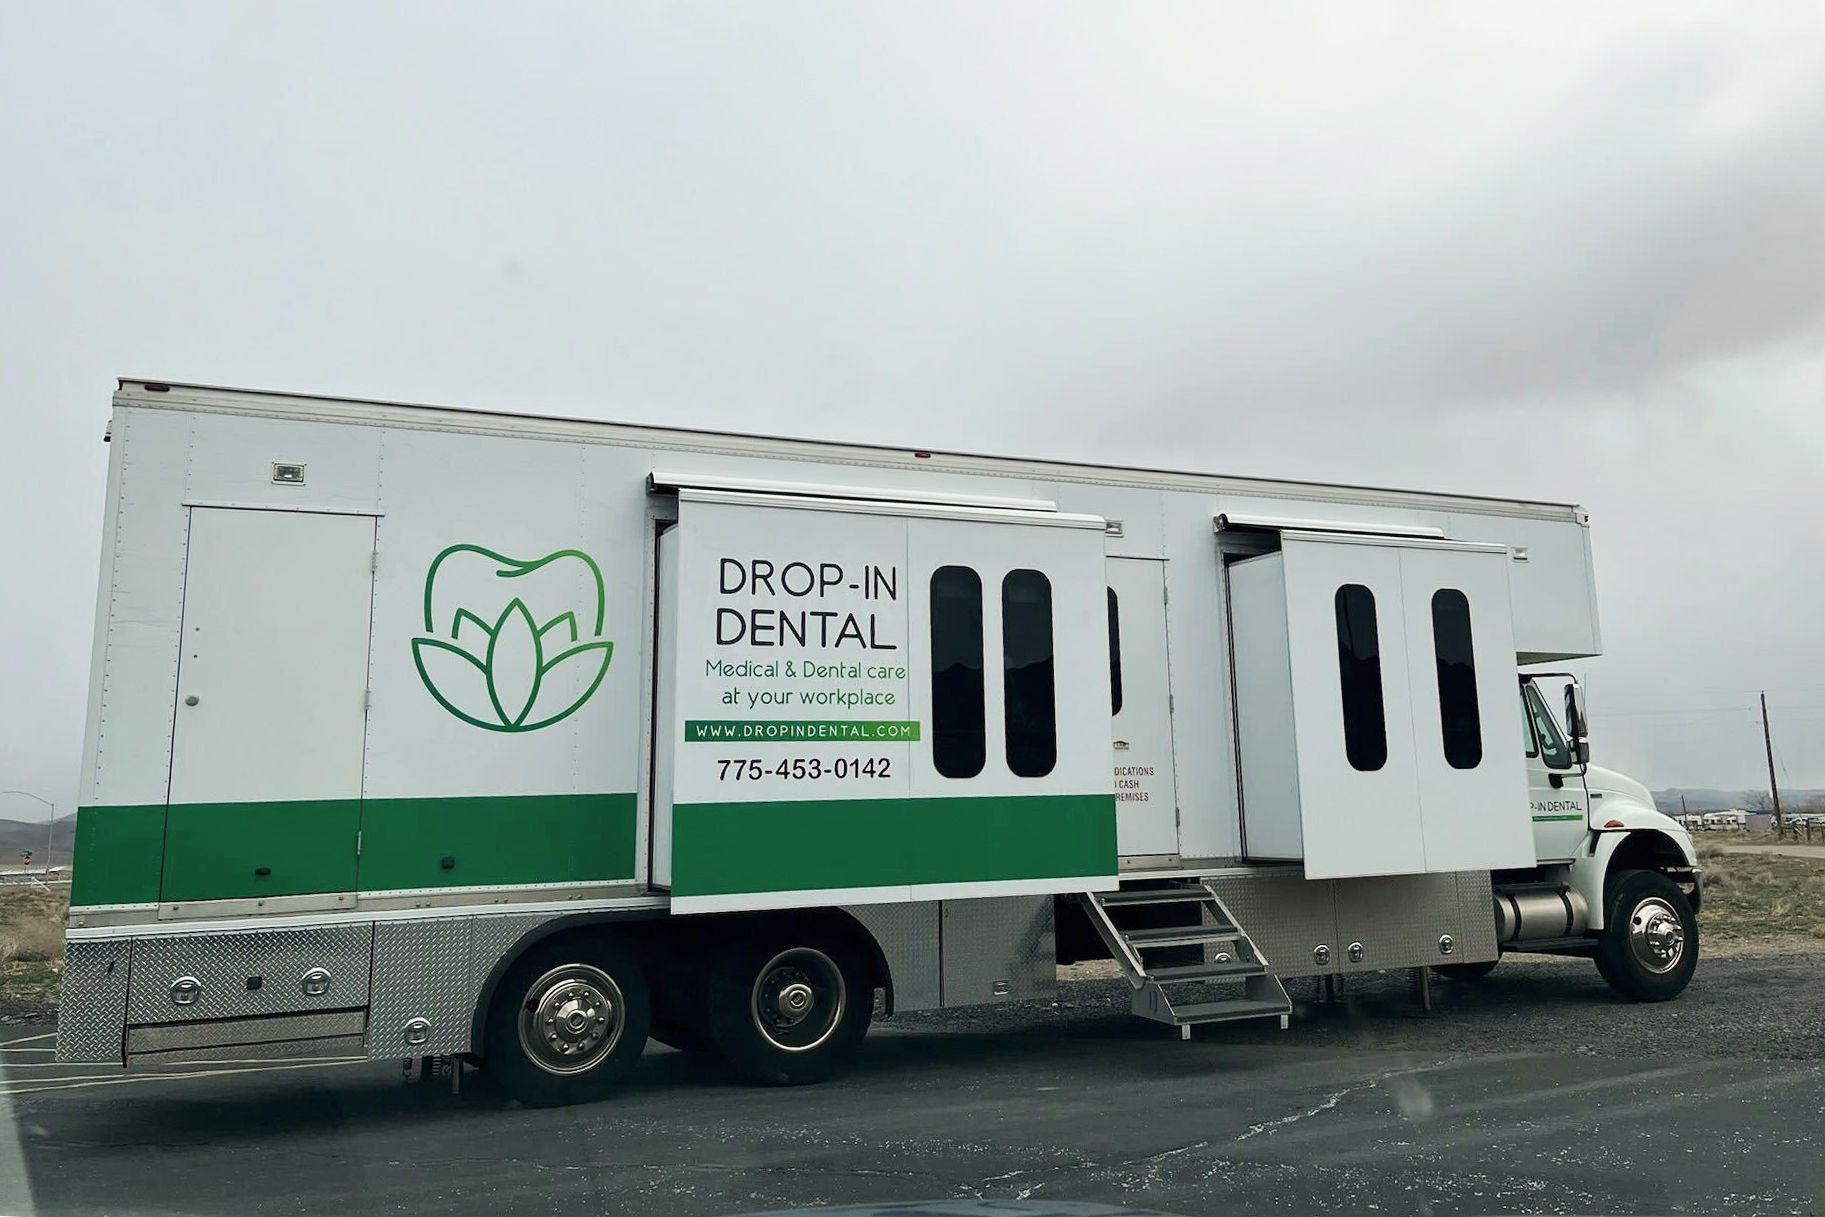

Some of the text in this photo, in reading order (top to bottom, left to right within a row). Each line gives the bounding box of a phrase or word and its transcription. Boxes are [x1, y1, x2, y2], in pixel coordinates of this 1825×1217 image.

[719, 558, 897, 600] DROP-IN
[716, 608, 898, 650] DENTAL
[705, 659, 906, 679] Medical & Dental care
[722, 687, 896, 710] at your workplace
[695, 724, 911, 738] WWW.DROPINDENTAL.COM
[717, 757, 892, 781] 775-453-0142
[1118, 779, 1140, 789] CASH
[1547, 800, 1582, 812] DENTAL
